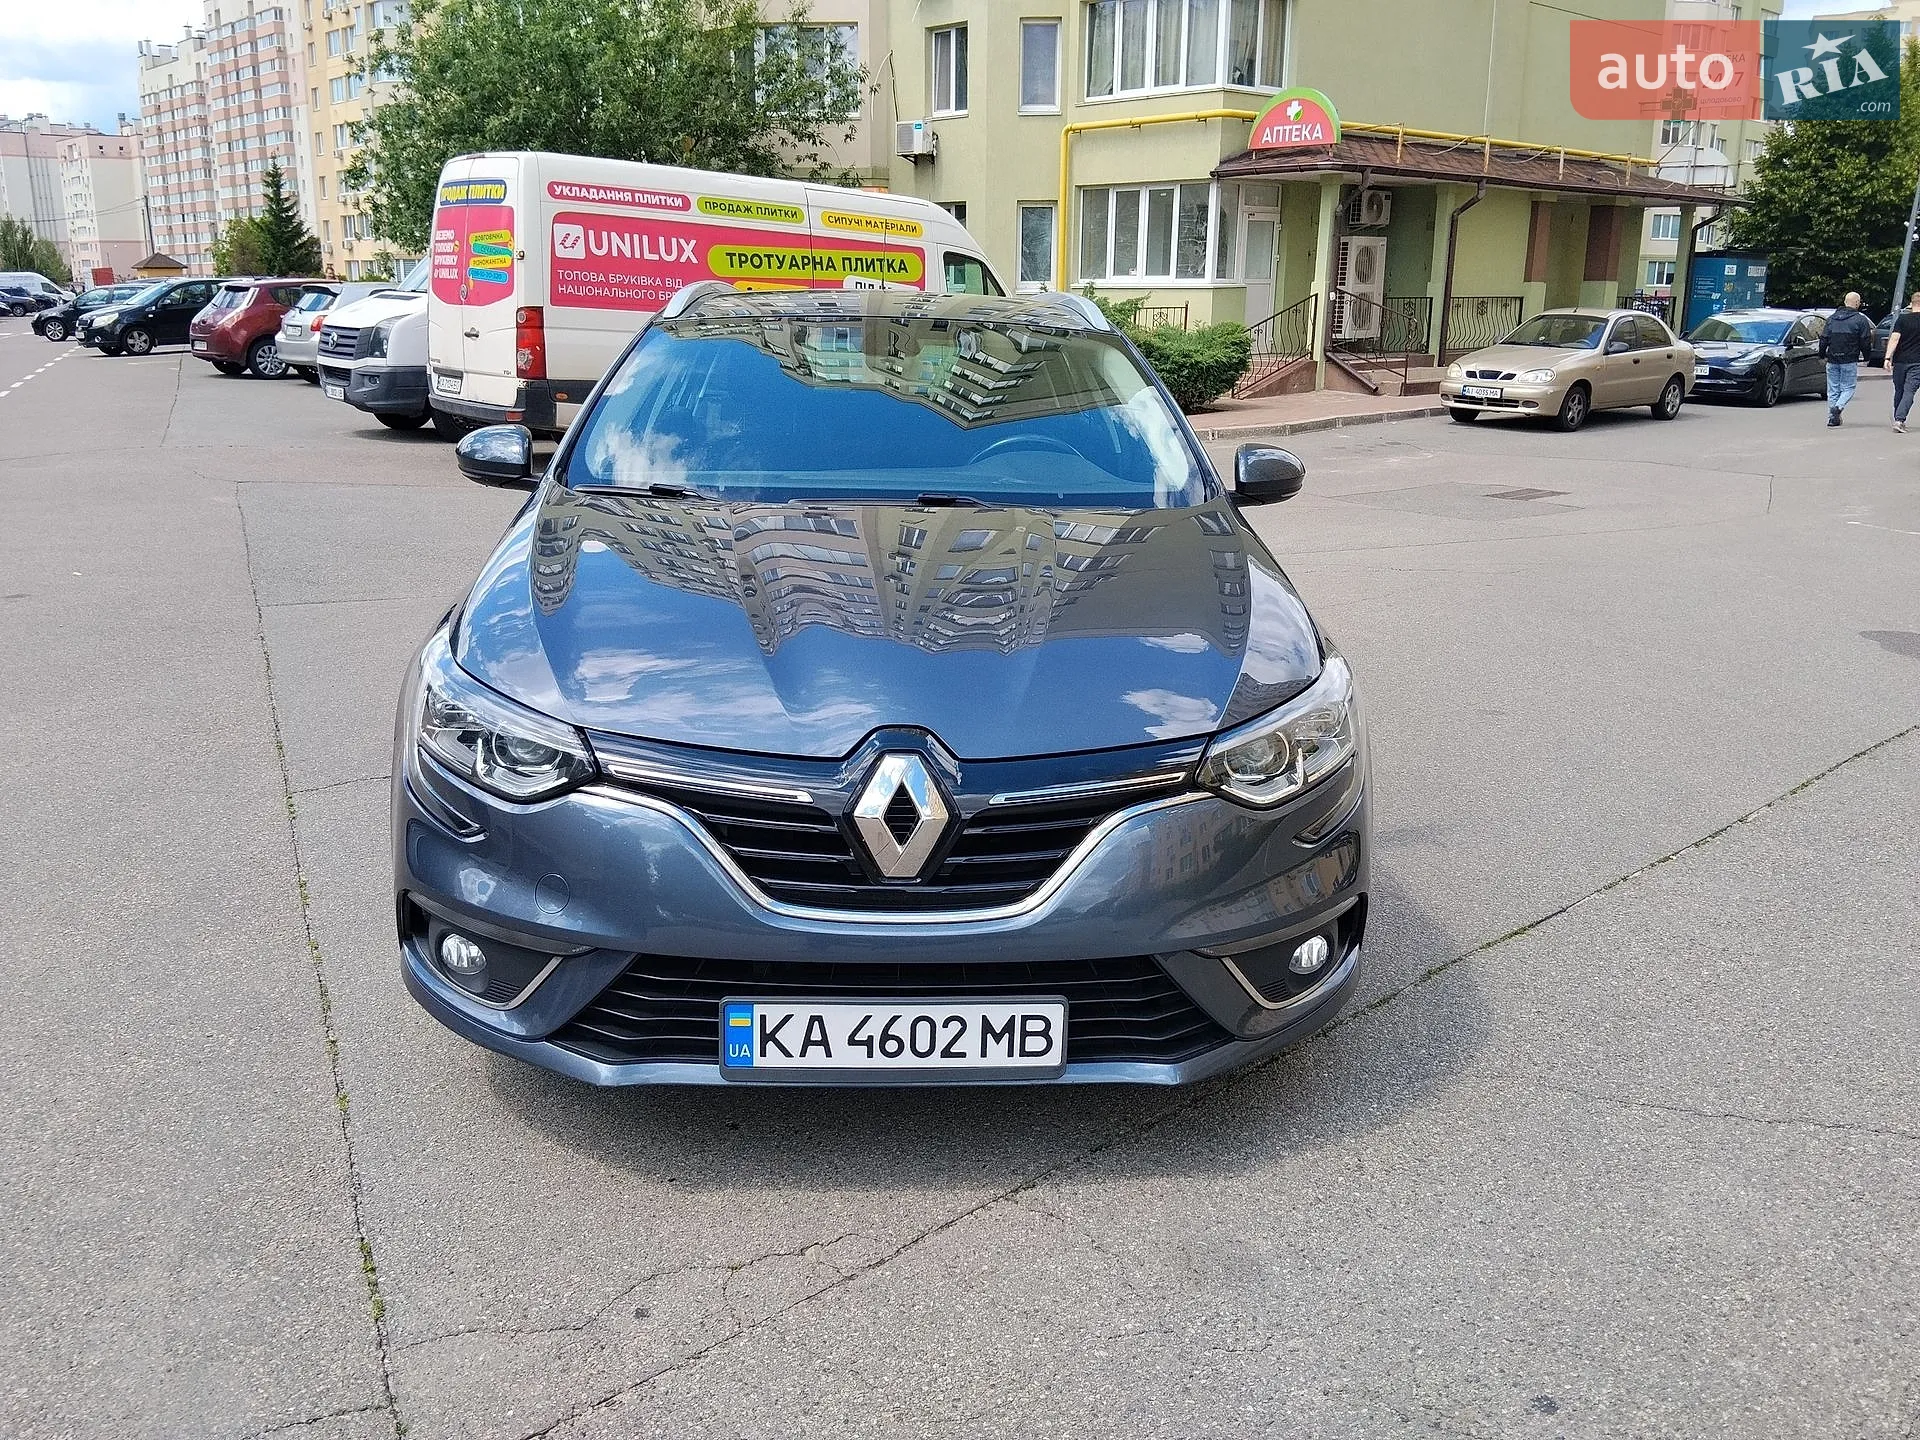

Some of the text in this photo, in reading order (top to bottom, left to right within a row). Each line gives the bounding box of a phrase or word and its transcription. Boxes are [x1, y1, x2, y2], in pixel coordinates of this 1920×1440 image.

[1261, 122, 1324, 144] АПТЕКА
[468, 183, 505, 200] ПЛИТКИ
[553, 184, 684, 208] УКЛАДАННЯ ПЛИТКИ
[704, 201, 798, 219] ПРОДАЖ ПЛИТКИ
[827, 215, 918, 234] СИПУЧІ МАТЕРІАЛИ
[588, 229, 699, 264] UNILUX
[725, 252, 909, 274] ТРОТУАРНА ПЛИТКА
[557, 269, 685, 290] ТОПОВА БРУКІВКА ВІД
[558, 284, 656, 300] НАЦІОНАЛЬНОГО
[759, 1013, 1053, 1059] KA 4602 MB
[729, 1044, 751, 1058] UA
